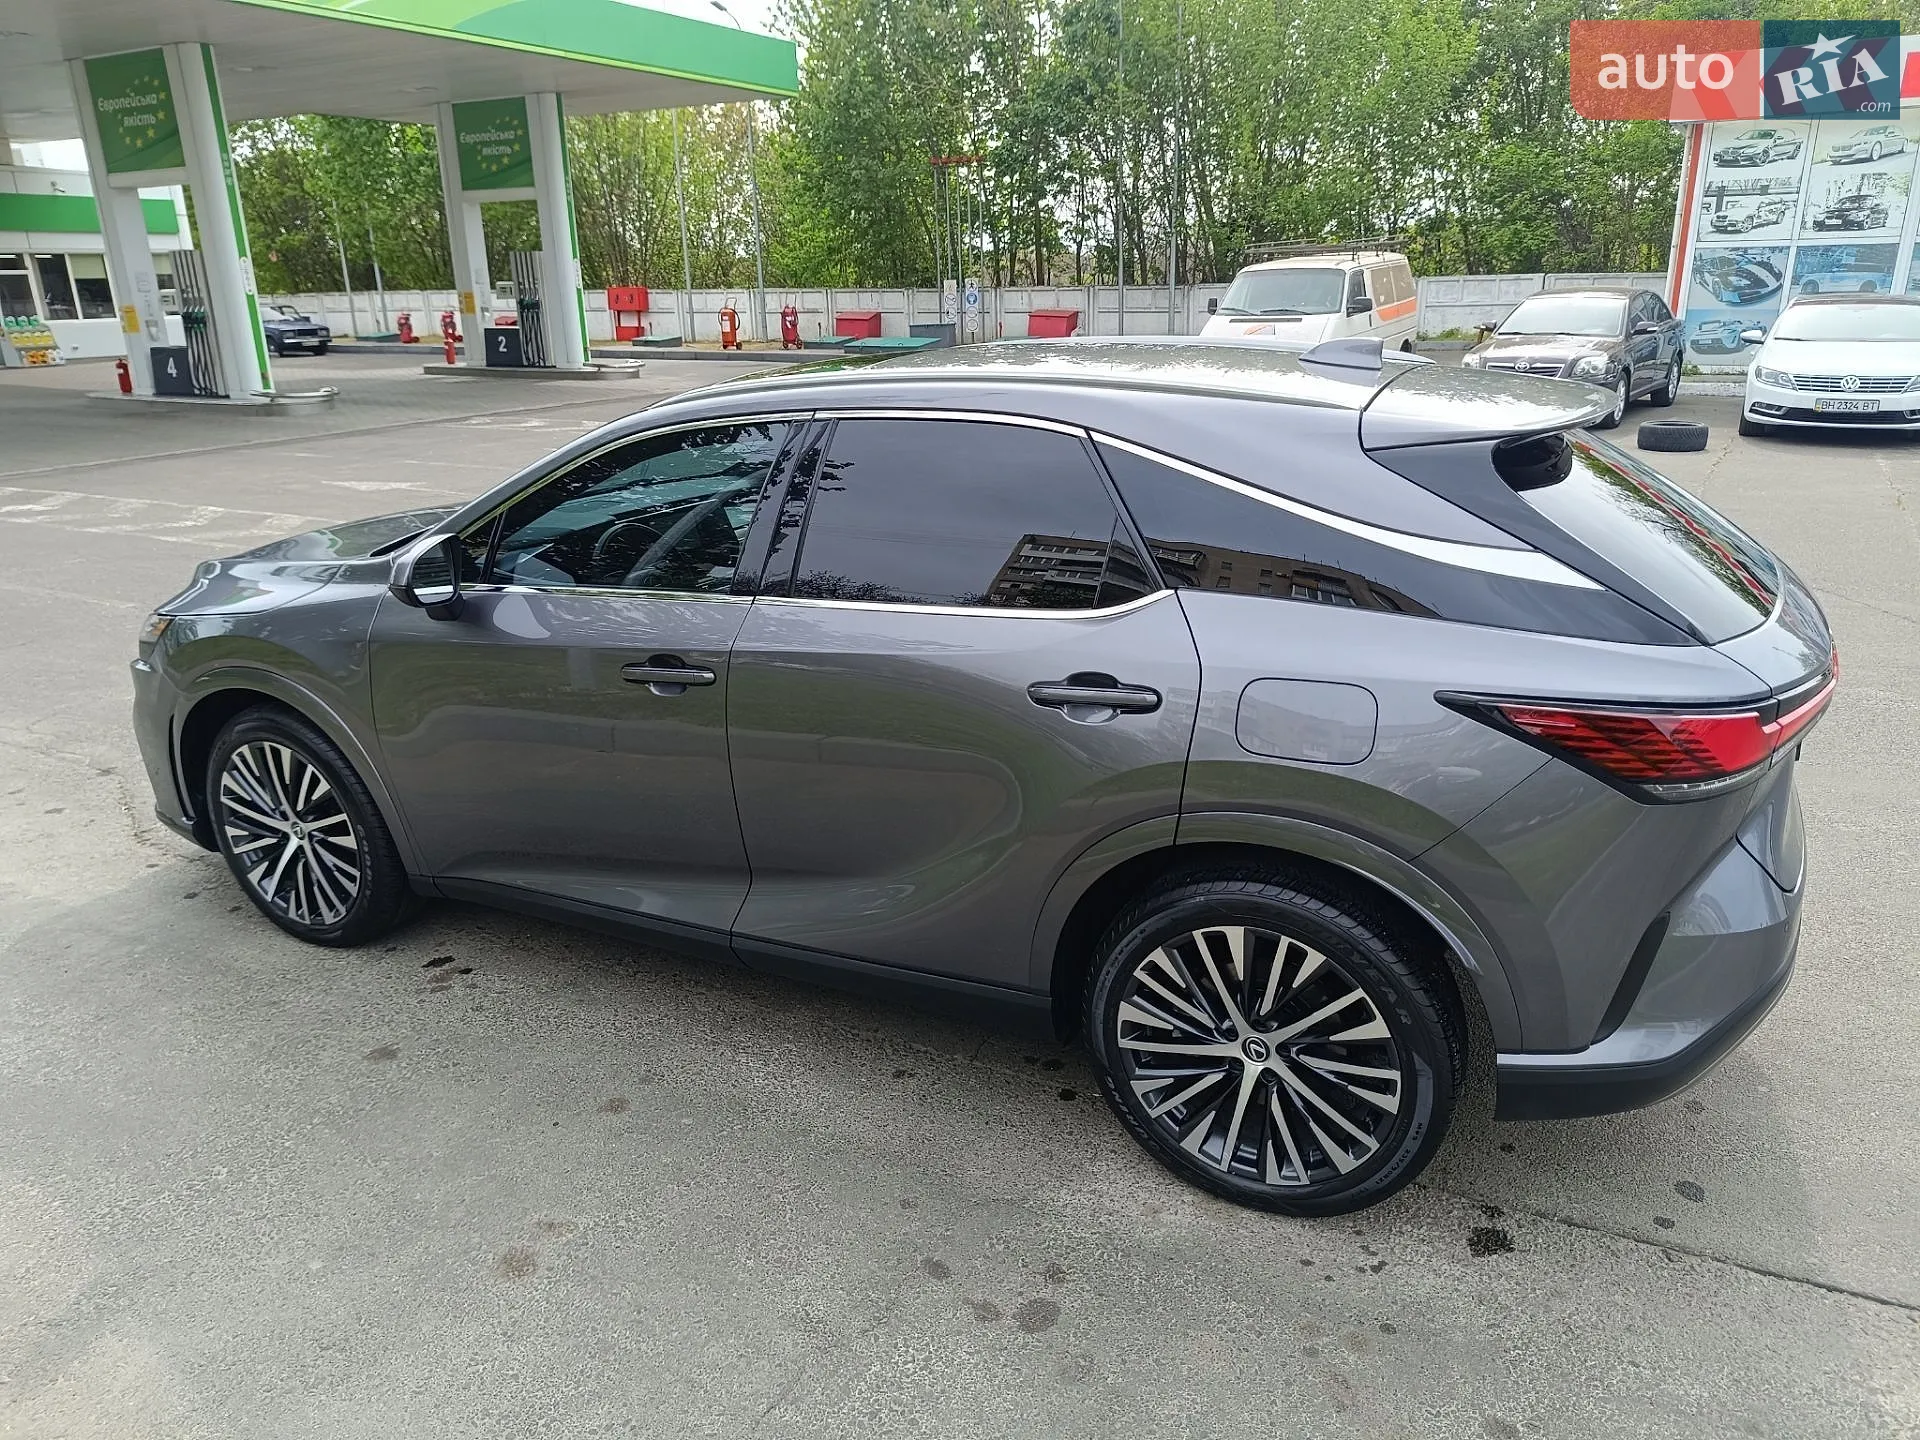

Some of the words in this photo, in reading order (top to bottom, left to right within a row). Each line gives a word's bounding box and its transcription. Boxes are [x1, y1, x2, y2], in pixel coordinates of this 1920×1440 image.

[98, 92, 158, 113] Європейська
[123, 113, 157, 127] якість
[498, 336, 507, 352] 2
[167, 357, 177, 378] 4
[1821, 401, 1835, 410] BH
[1837, 401, 1859, 410] 2324
[1862, 402, 1877, 410] BT
